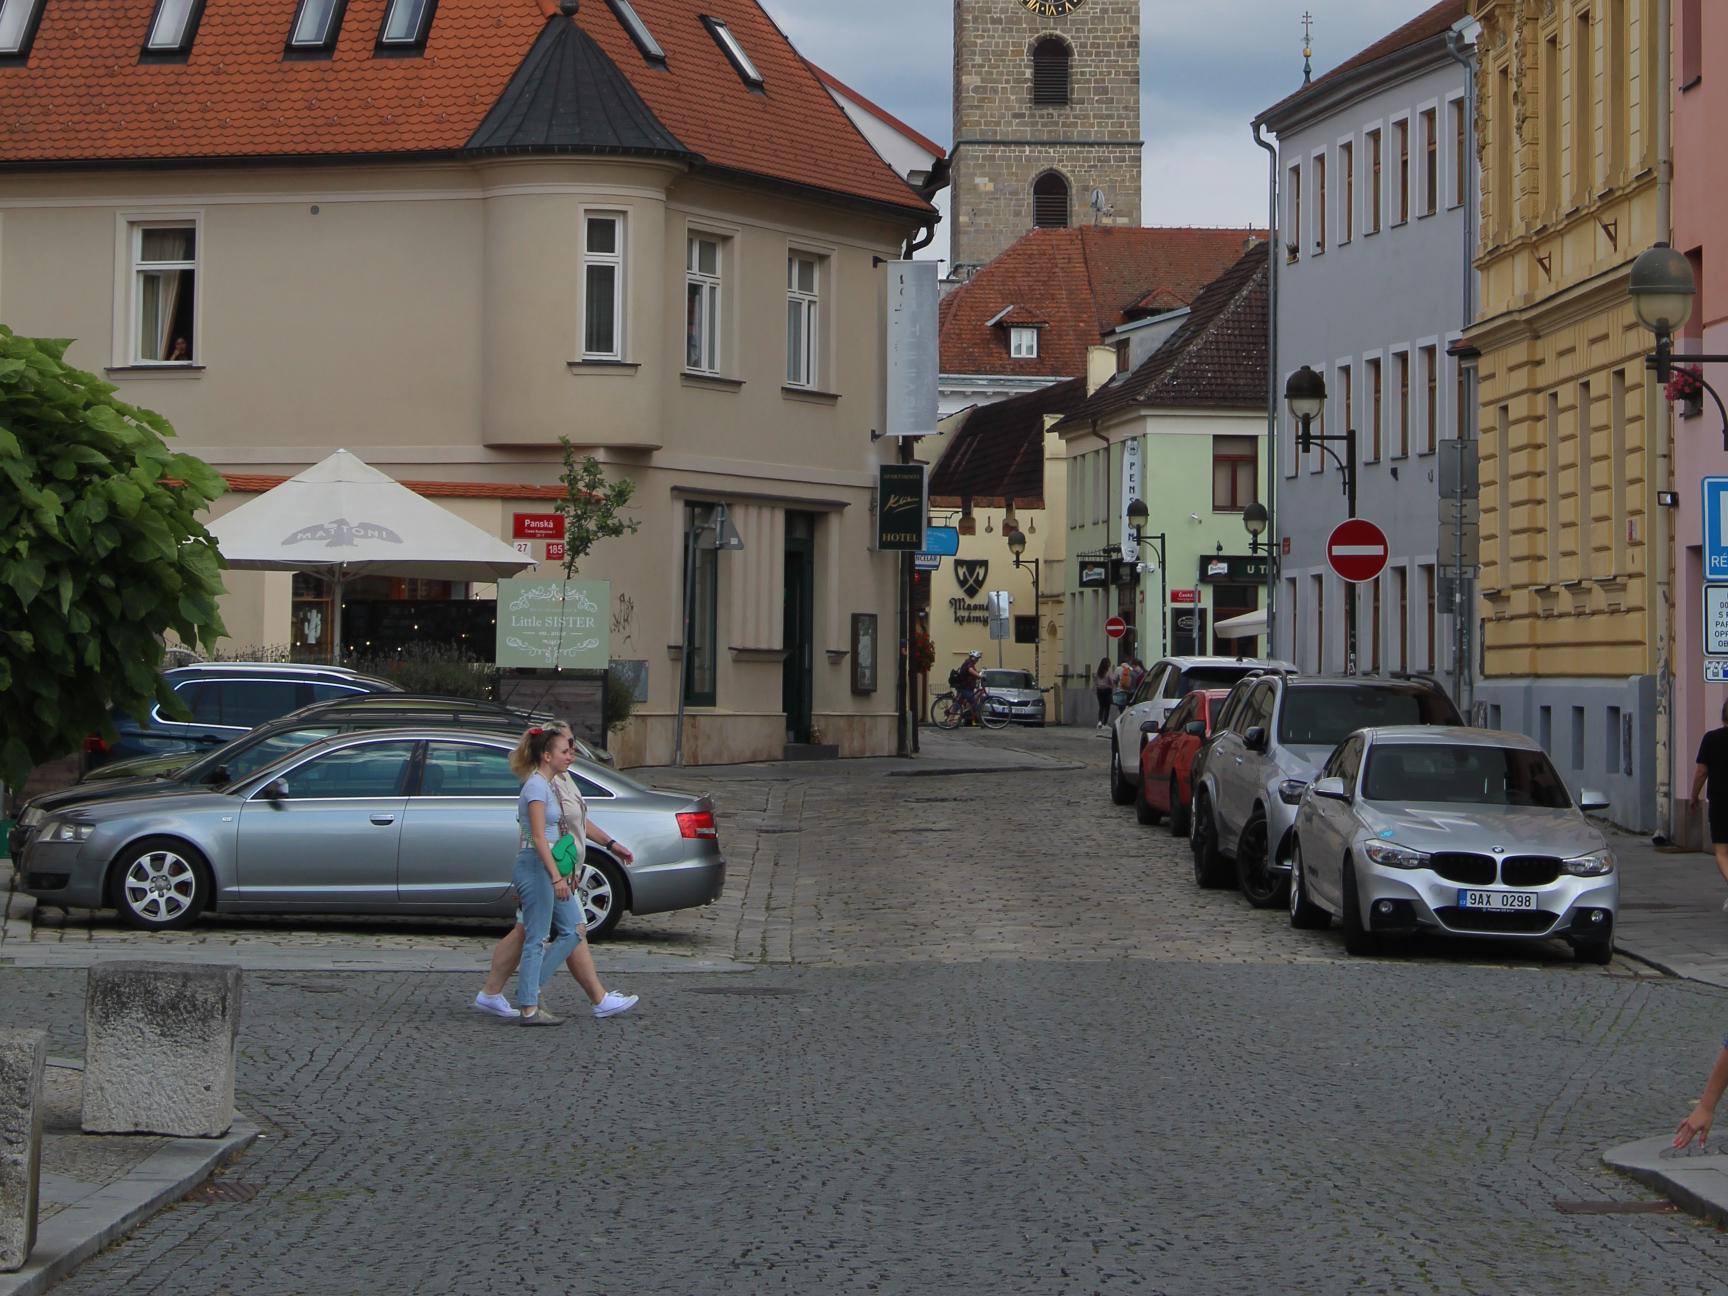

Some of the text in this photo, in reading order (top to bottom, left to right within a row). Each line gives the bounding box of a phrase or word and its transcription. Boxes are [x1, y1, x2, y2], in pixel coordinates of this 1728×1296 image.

[524, 519, 554, 528] Panská
[297, 524, 388, 539] MATTONI
[882, 533, 919, 542] HOTEL
[517, 543, 528, 553] 27
[548, 544, 563, 554] 185
[511, 616, 596, 628] Little SISTER
[1469, 893, 1531, 907] 9AX 0298
